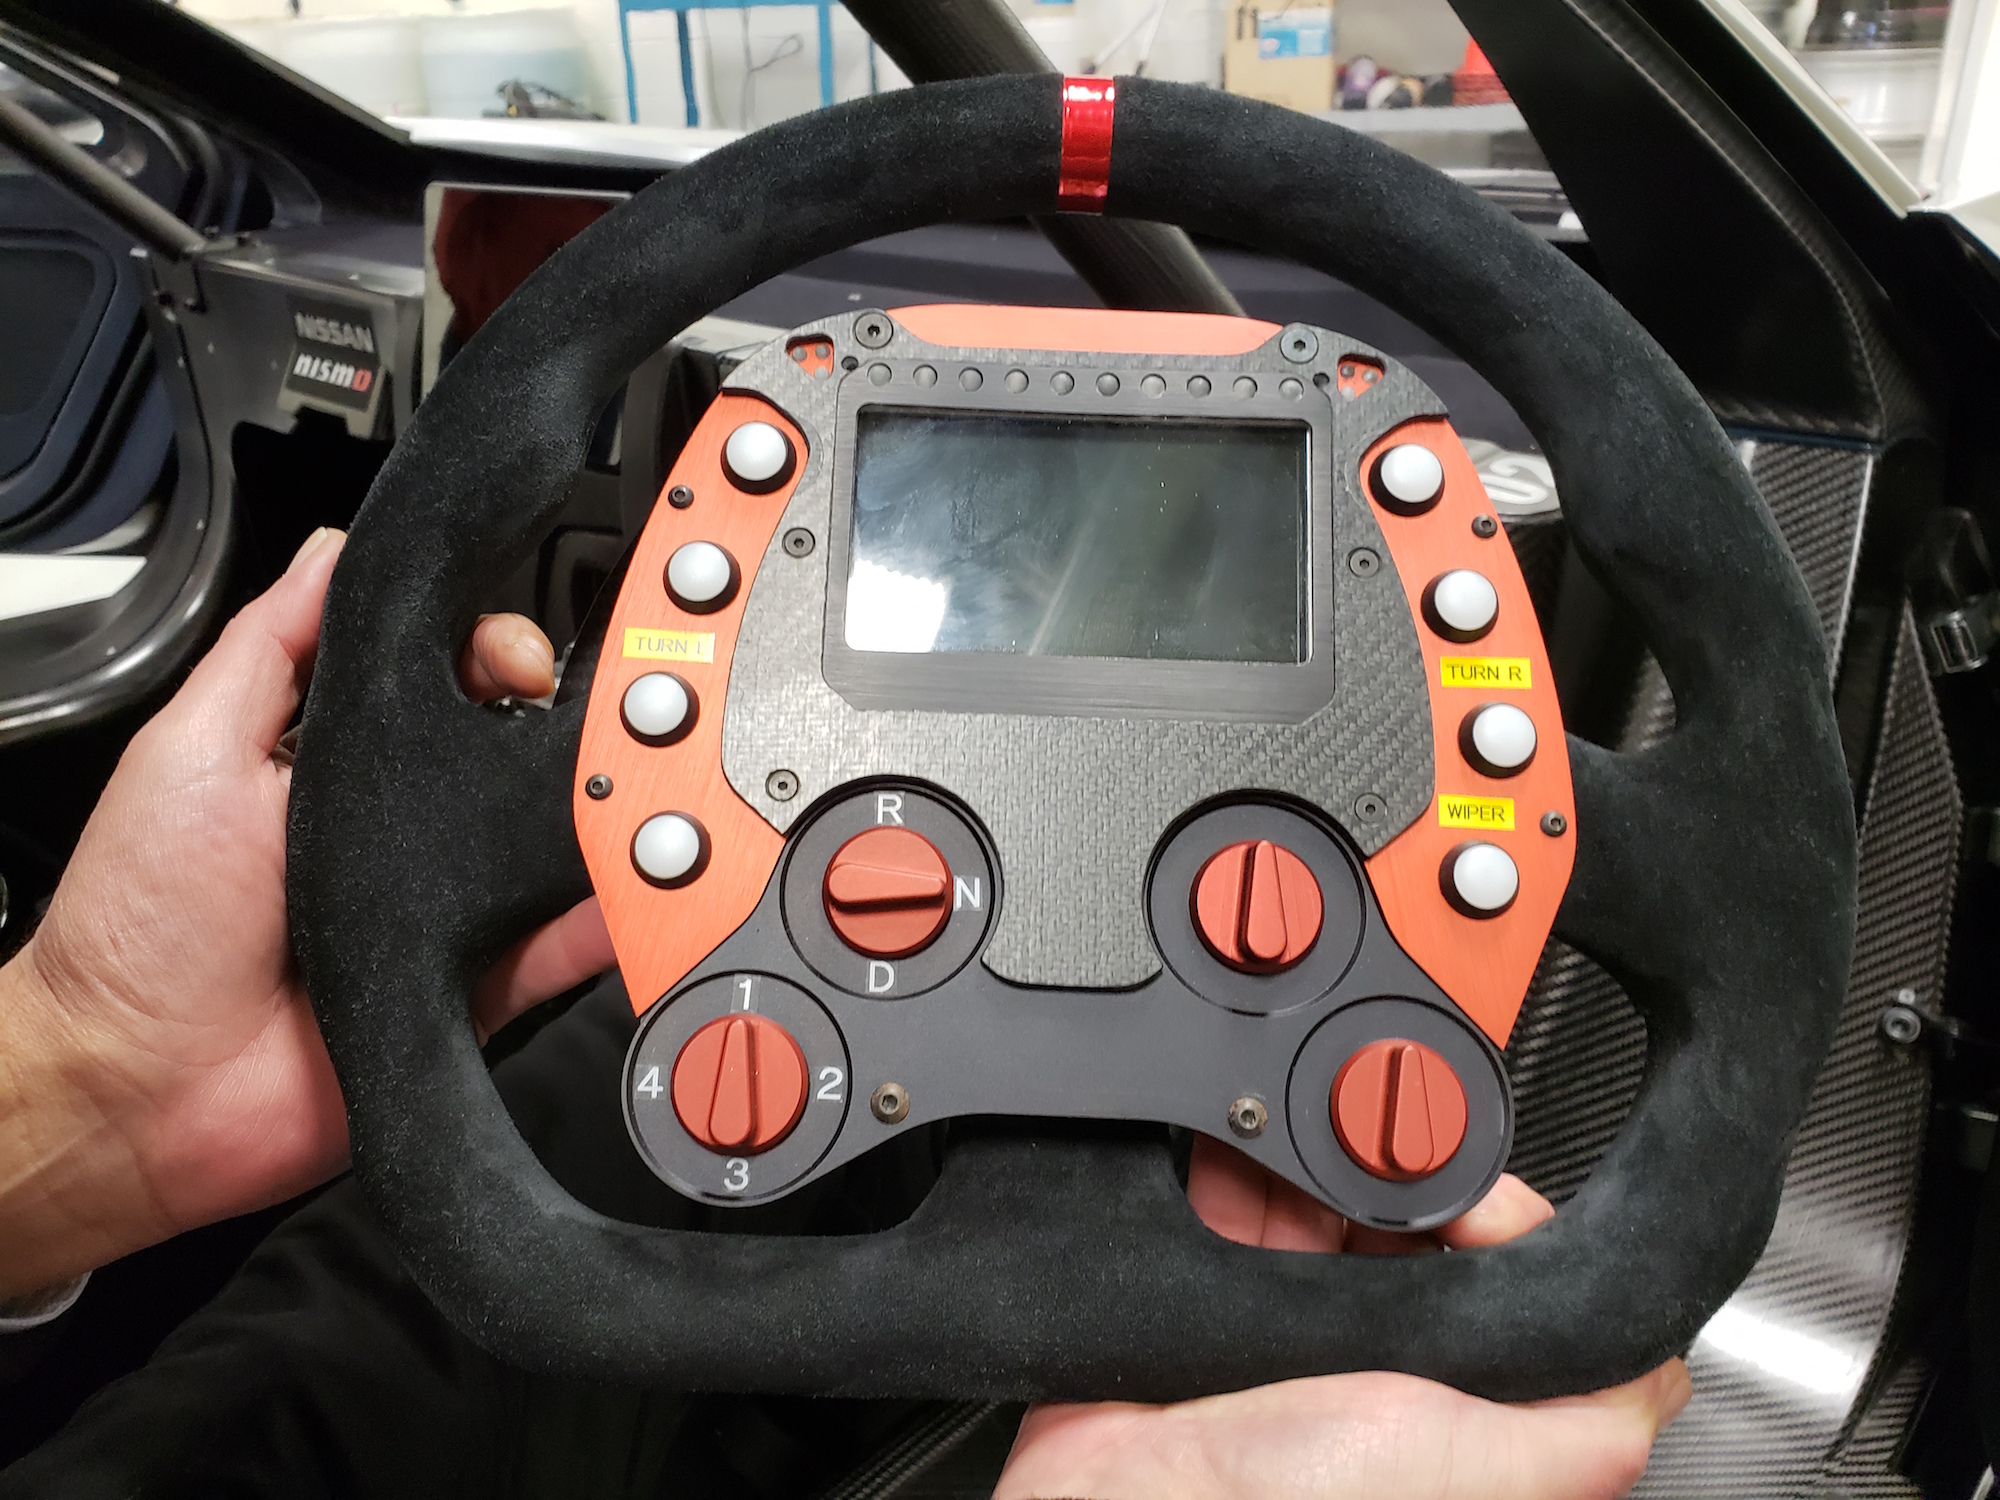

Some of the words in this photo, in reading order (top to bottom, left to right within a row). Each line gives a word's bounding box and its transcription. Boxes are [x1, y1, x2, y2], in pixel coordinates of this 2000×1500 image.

[293, 311, 375, 353] NISSAN
[635, 636, 687, 654] TURN
[1447, 664, 1499, 681] TURN
[1508, 666, 1522, 681] R
[876, 794, 904, 825] R
[1448, 803, 1505, 822] WIPER
[955, 877, 980, 908] N
[868, 961, 895, 993] D
[739, 978, 753, 1011] 1
[637, 1066, 664, 1099] 4
[816, 1066, 843, 1101] 2
[723, 1158, 750, 1191] 3
